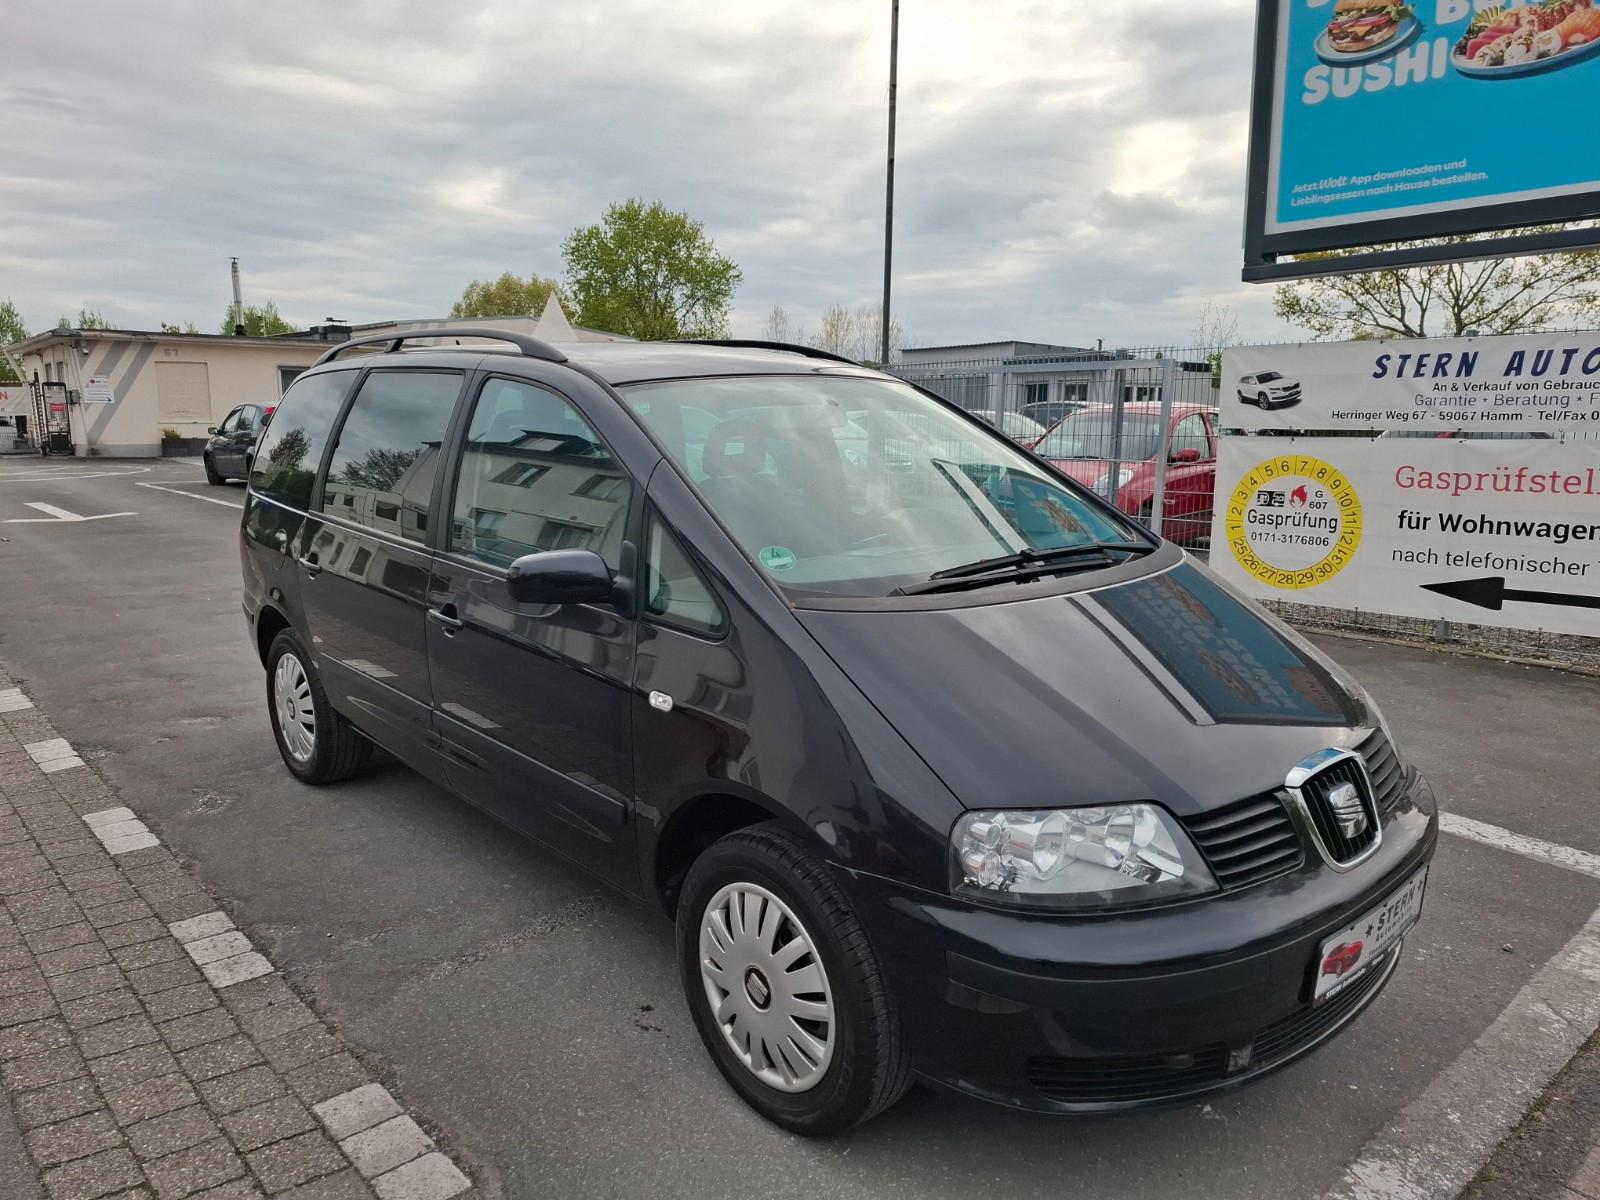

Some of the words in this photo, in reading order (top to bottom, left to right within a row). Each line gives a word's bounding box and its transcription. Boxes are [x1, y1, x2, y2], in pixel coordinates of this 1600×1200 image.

[1302, 38, 1447, 104] SUSHI
[1292, 182, 1318, 193] Jetzt
[1319, 176, 1347, 189] Wolt
[1350, 175, 1371, 187] App
[1373, 165, 1442, 180] downloaden
[1443, 159, 1467, 171] und
[1291, 190, 1365, 206] Lieblingsessen
[1366, 184, 1393, 196] nach
[1394, 180, 1429, 192] Hause
[1431, 171, 1489, 186] bestellen.
[1372, 351, 1479, 379] STERN
[1503, 347, 1600, 377] AUTO
[1432, 382, 1447, 392] An
[1450, 382, 1459, 392] &
[1463, 381, 1512, 392] Verkauf
[1515, 382, 1539, 391] von
[1414, 394, 1476, 407] Garantie
[1494, 393, 1570, 408] Beratung
[1332, 409, 1383, 421] Herringer
[1386, 410, 1409, 422] Weg
[1412, 410, 1427, 420] 67
[1438, 411, 1477, 421] 59067
[1481, 410, 1523, 421] Hamm
[1537, 409, 1587, 421] Tel/Fax
[1264, 465, 1273, 477] 5
[1281, 460, 1289, 472] 6
[1300, 461, 1308, 472] 7
[1316, 467, 1327, 479] 8
[1250, 477, 1258, 487] 4
[1330, 479, 1342, 490] 9
[1395, 465, 1600, 497] Gasprüfstel
[1237, 490, 1248, 500] 3
[1315, 490, 1324, 499] G
[1338, 492, 1353, 507] 10
[1231, 506, 1243, 515] 2
[1309, 501, 1328, 510] 607
[1247, 508, 1338, 534] Gasprüfung
[1345, 511, 1357, 525] 11
[1398, 509, 1432, 531] für
[1251, 532, 1330, 547] 0171-3176806
[1340, 529, 1355, 545] 12
[1233, 539, 1248, 555] 25
[1243, 554, 1260, 570] 26
[1332, 548, 1348, 565] 31
[1392, 547, 1438, 565] nach
[1445, 550, 1591, 576] telefonischer
[1259, 566, 1276, 580] 27
[1297, 571, 1314, 584] 29
[1315, 562, 1333, 578] 30
[1277, 573, 1294, 585] 28
[1377, 886, 1416, 931] STERN
